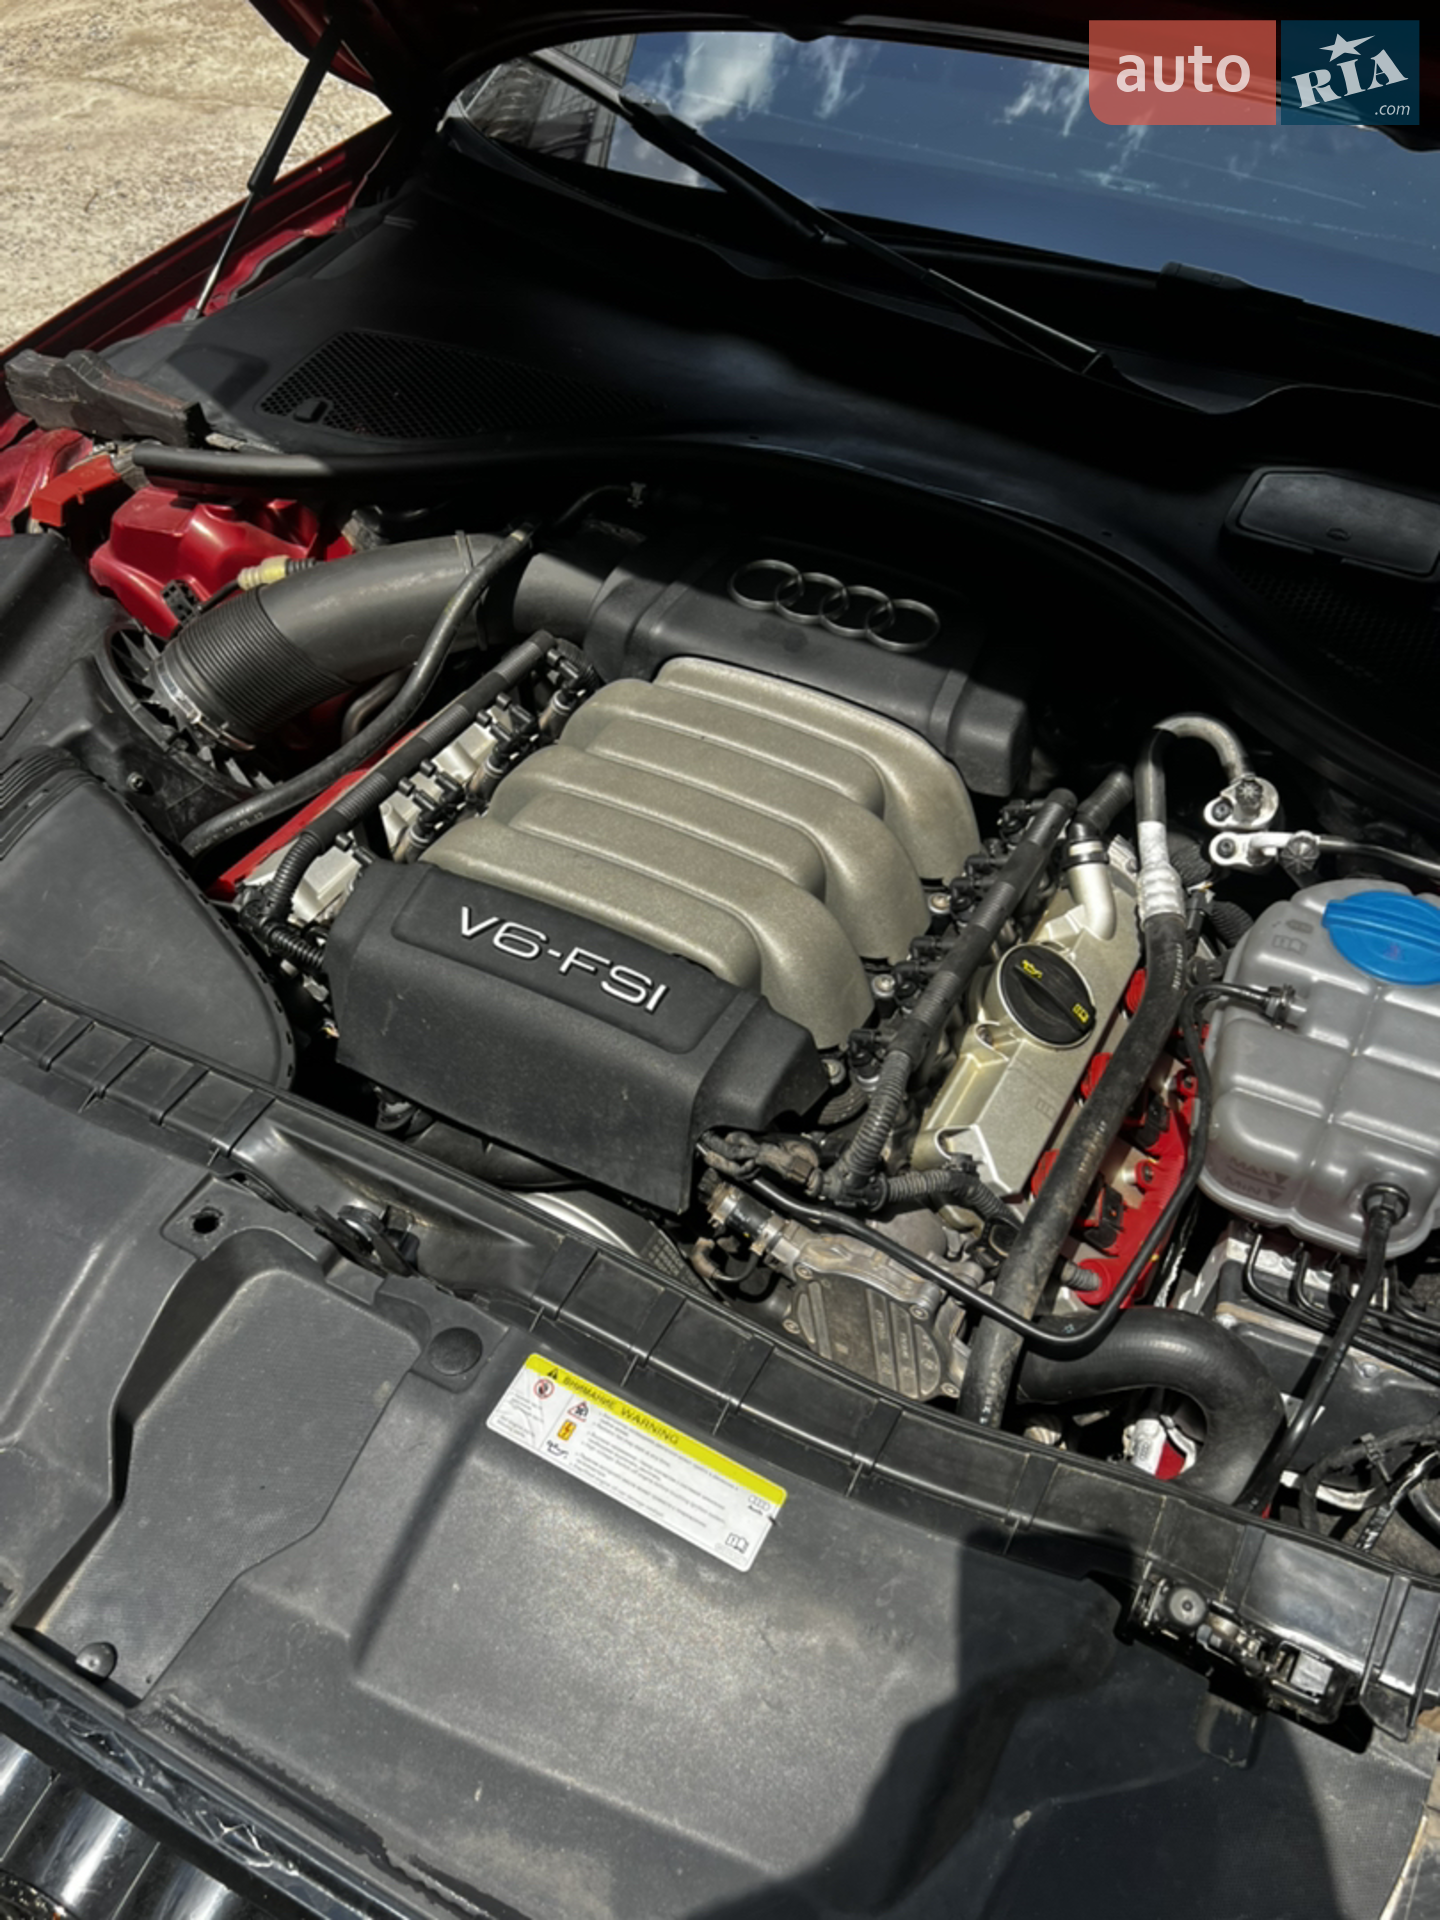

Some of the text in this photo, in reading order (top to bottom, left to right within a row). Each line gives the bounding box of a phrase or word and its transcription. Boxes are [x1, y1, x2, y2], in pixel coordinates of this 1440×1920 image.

[461, 905, 667, 1012] V6-FSI
[1229, 1155, 1271, 1178] MAX
[562, 1376, 616, 1411] ВНИМАНИЕ
[620, 1406, 680, 1446] WARNING
